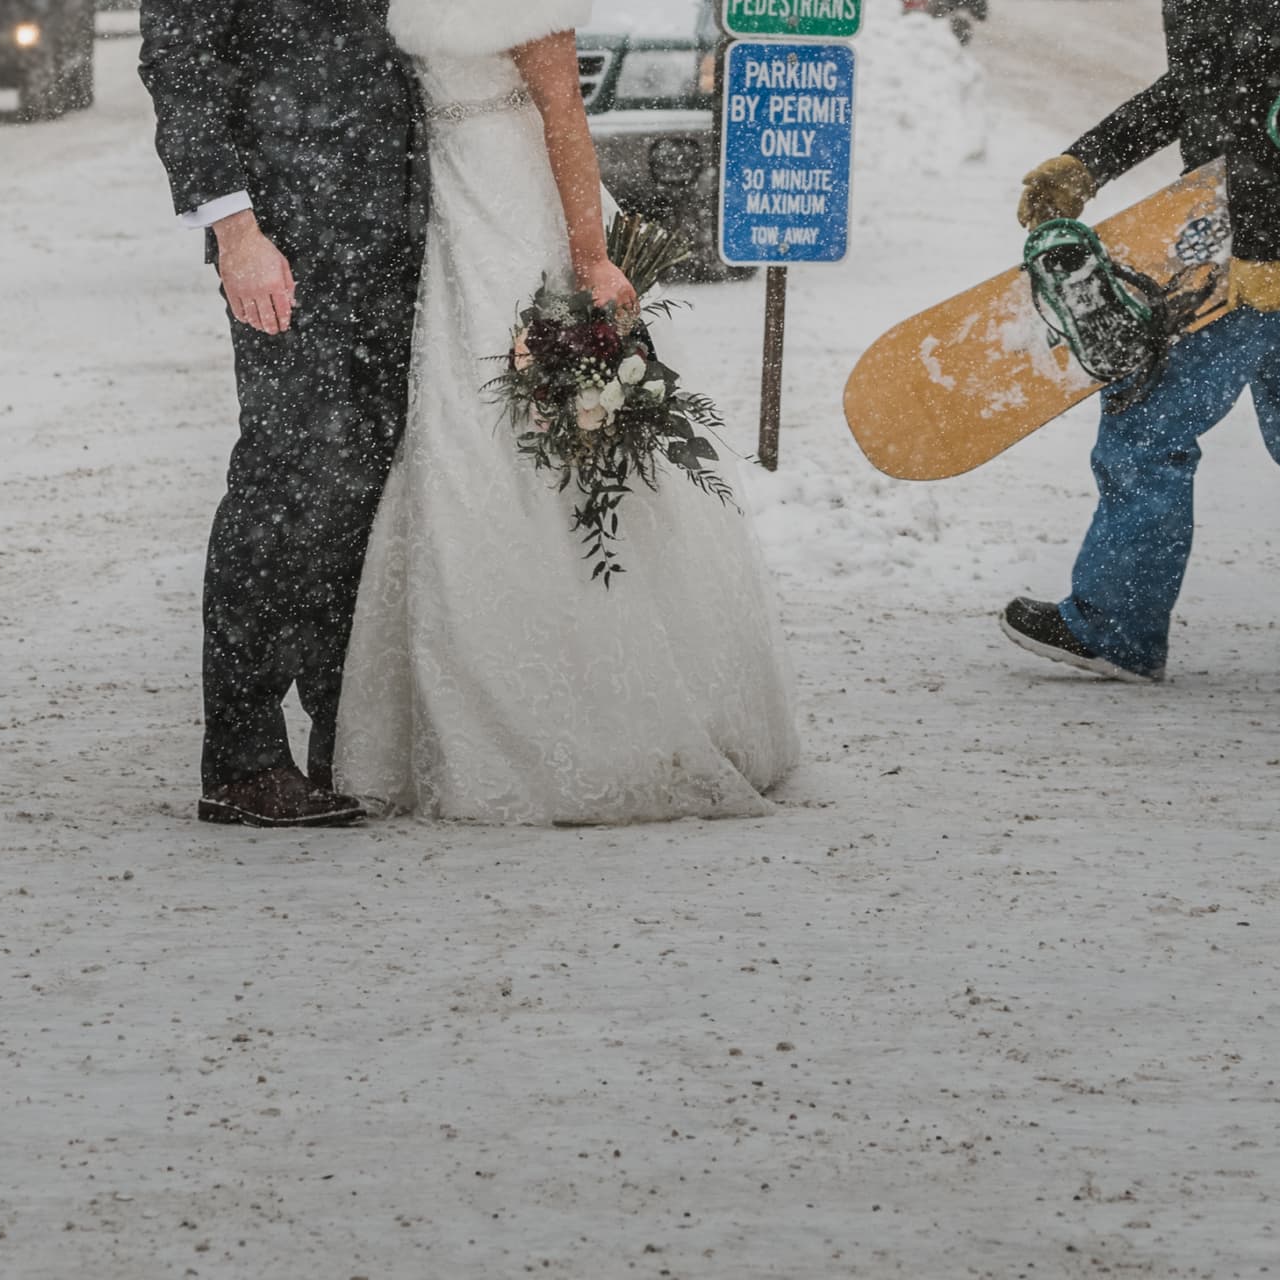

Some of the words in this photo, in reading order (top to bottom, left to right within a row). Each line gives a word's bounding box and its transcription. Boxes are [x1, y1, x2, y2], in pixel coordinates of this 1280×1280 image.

[745, 60, 838, 91] PARKING
[731, 94, 760, 122] BY
[769, 95, 849, 124] PERMIT
[761, 128, 816, 157] ONLY
[742, 169, 765, 191] 30
[771, 169, 833, 192] MINUTE
[746, 193, 826, 215] MAXIMUM
[751, 226, 779, 245] TOW
[784, 227, 819, 245] AWAY
